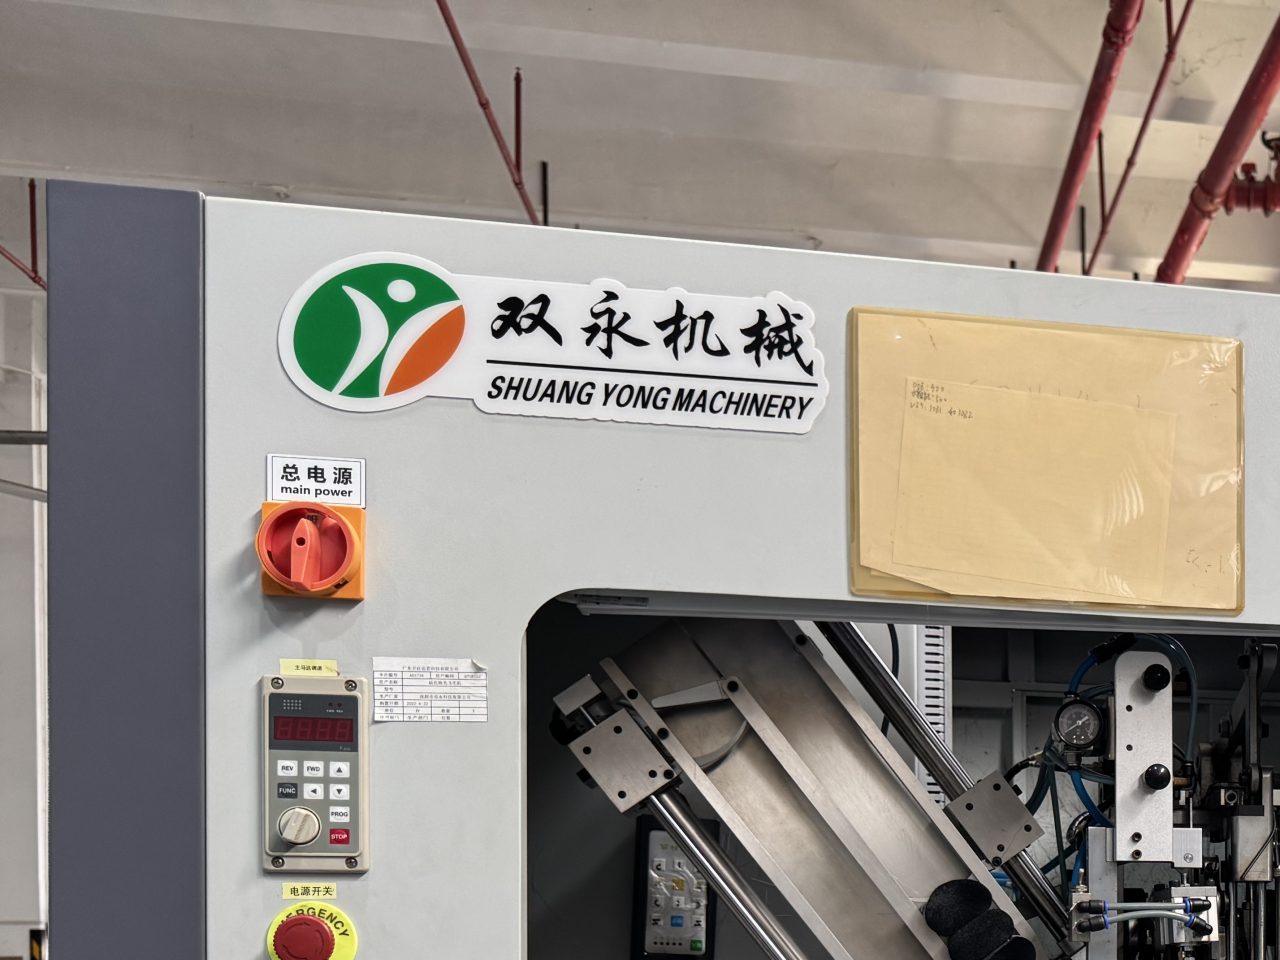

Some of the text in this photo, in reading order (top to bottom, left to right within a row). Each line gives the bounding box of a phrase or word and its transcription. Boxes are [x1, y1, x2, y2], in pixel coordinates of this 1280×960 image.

[490, 289, 814, 377] 双永机械
[486, 375, 814, 420] SHUANG YONG MACHINERY
[280, 463, 353, 485] 总电源
[280, 484, 353, 499] main power
[281, 764, 294, 772] REV
[306, 765, 321, 773] FWD
[279, 787, 296, 795] FUNC
[330, 833, 348, 841] STOP
[290, 886, 334, 896] 电源开关
[281, 907, 350, 937] RGENCY
